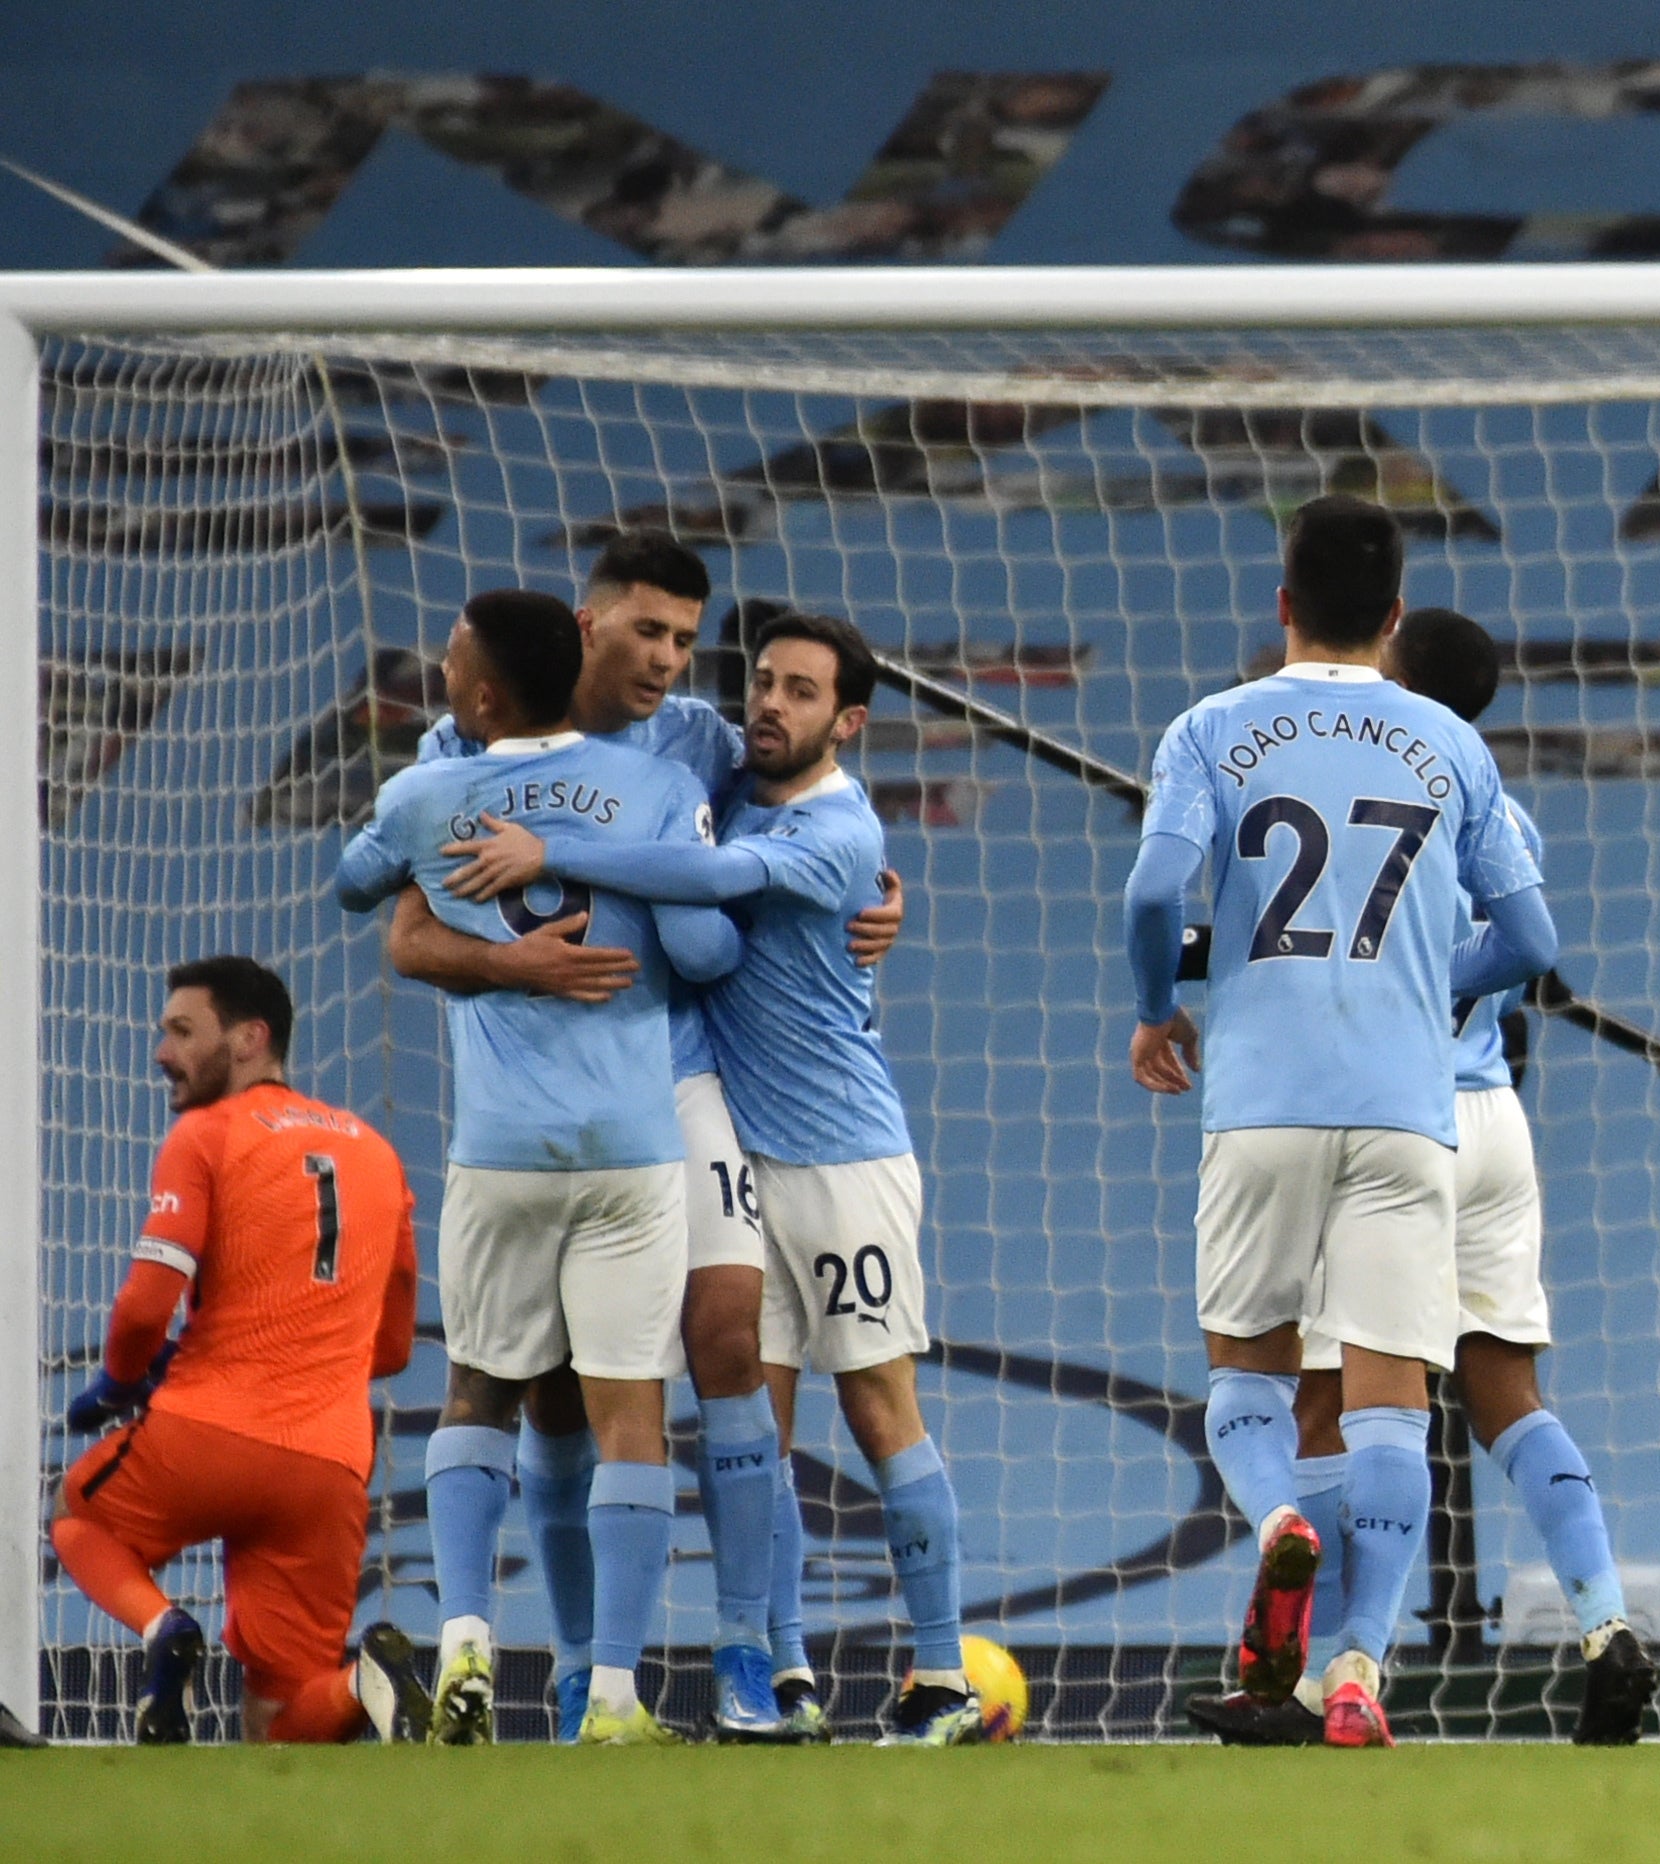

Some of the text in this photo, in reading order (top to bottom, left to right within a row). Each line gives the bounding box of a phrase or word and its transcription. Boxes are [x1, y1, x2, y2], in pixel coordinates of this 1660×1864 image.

[1217, 711, 1451, 800] JOÃO CANCELO
[500, 780, 622, 826] JESUS
[1237, 794, 1443, 963] 27
[303, 1152, 341, 1284] 1
[710, 1160, 760, 1220] 16
[813, 1244, 893, 1316] 20
[1217, 1414, 1274, 1439] CITY
[1355, 1517, 1414, 1536] CITY
